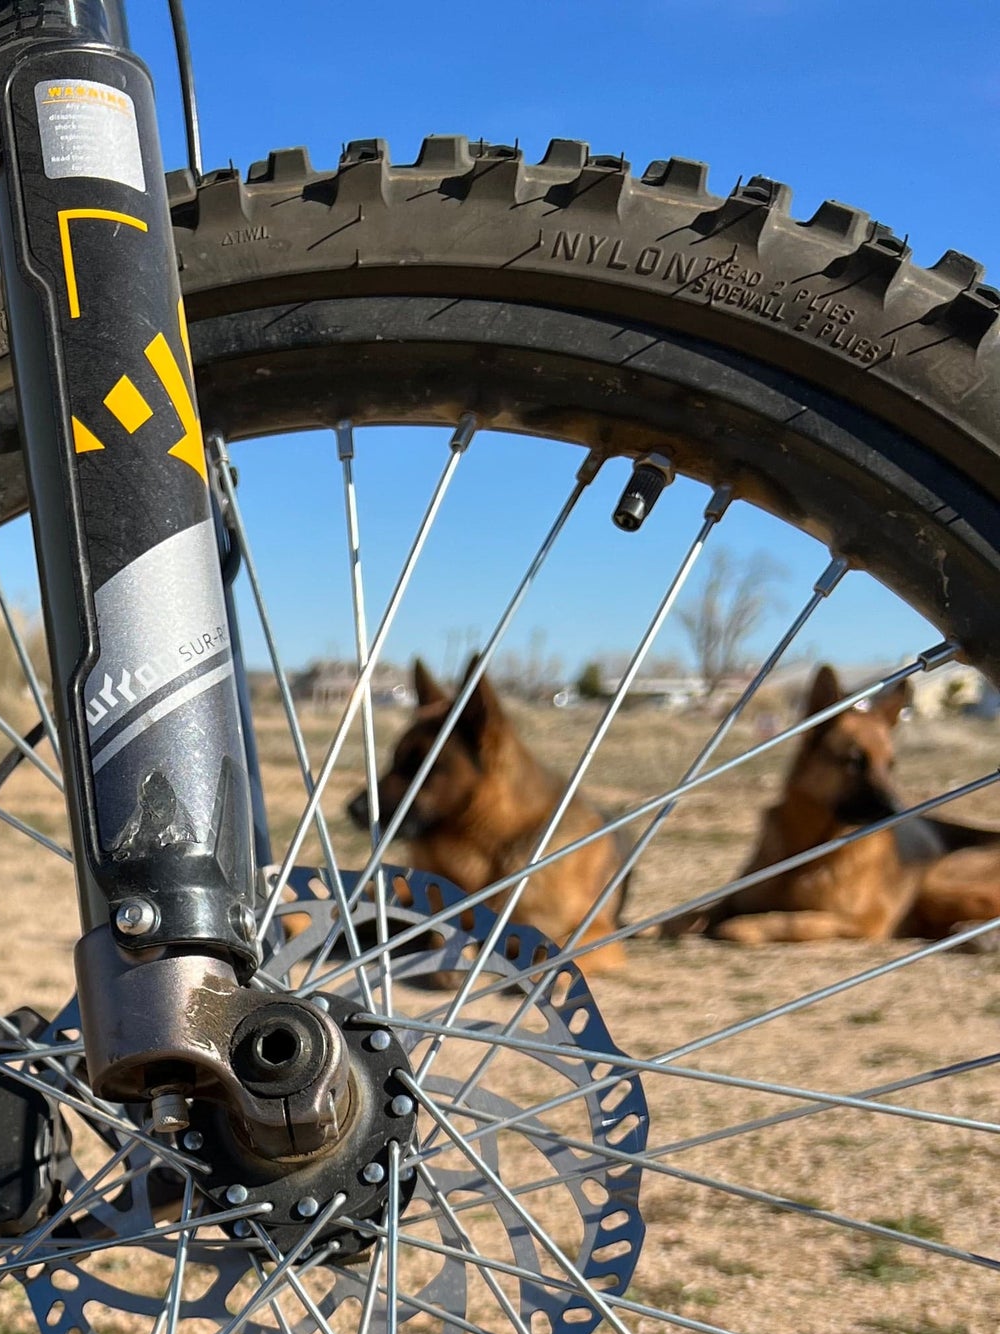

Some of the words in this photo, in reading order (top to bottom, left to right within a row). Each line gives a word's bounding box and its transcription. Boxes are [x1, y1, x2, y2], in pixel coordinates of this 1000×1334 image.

[551, 230, 698, 286] NYLON
[704, 256, 764, 288] TREAD
[769, 280, 788, 297] 2
[792, 288, 858, 325] PLIES
[690, 276, 786, 323] SIDEWALL
[793, 314, 814, 332] 2
[815, 322, 882, 364] PLIES
